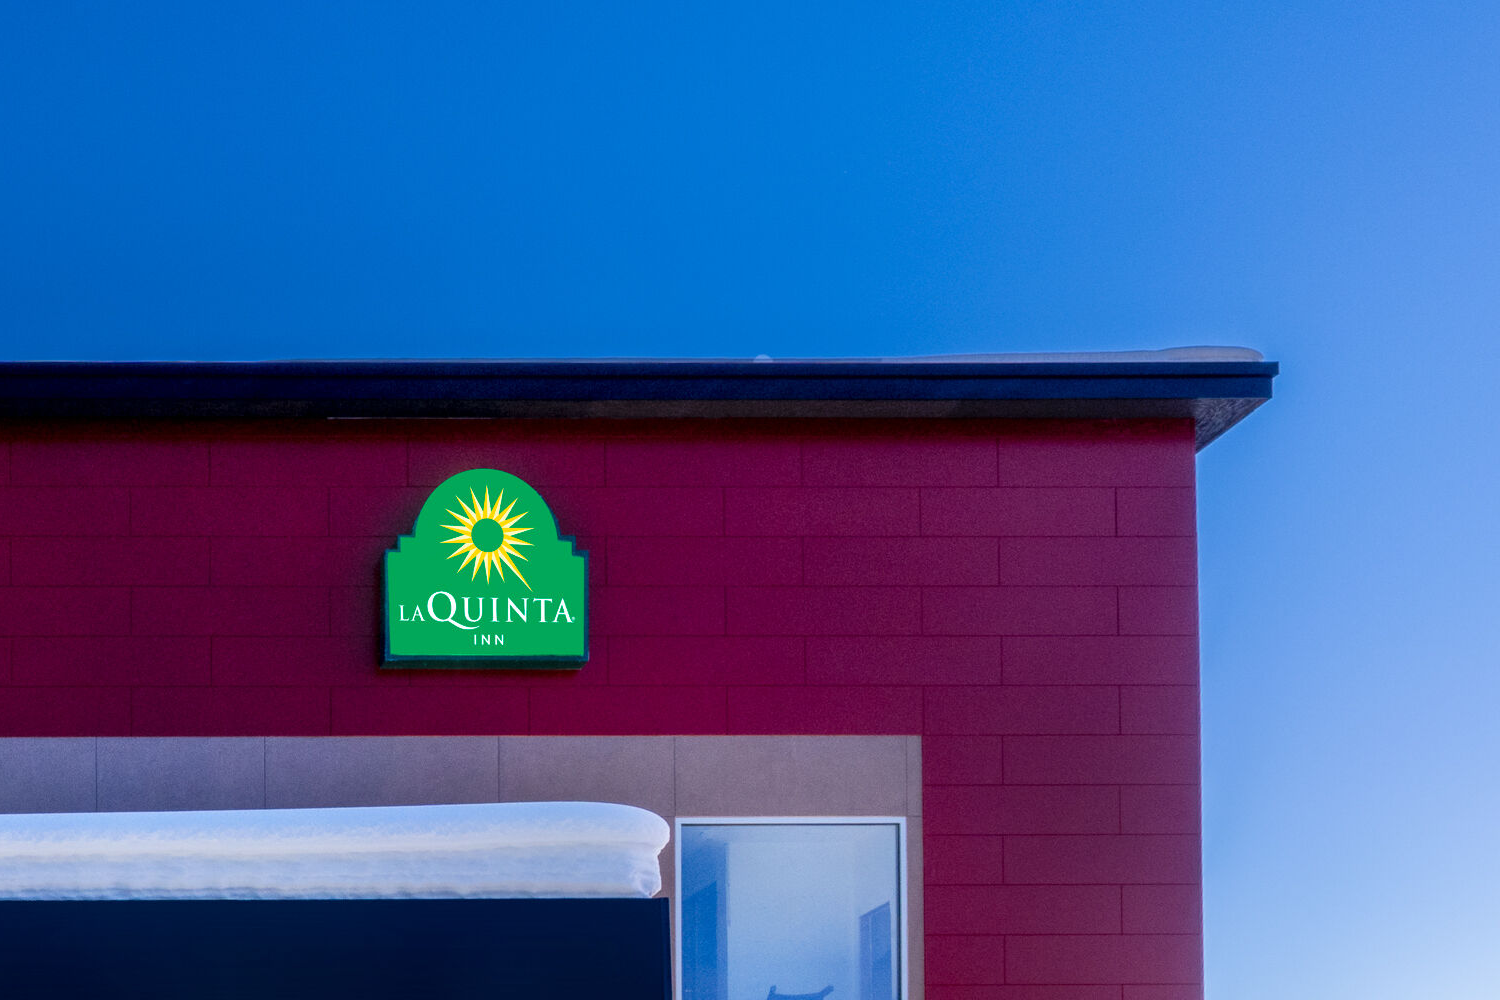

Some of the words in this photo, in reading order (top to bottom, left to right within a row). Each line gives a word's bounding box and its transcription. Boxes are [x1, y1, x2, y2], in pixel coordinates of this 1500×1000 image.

[399, 604, 426, 622] LA
[427, 590, 574, 630] QUINTA
[473, 634, 505, 646] INN
